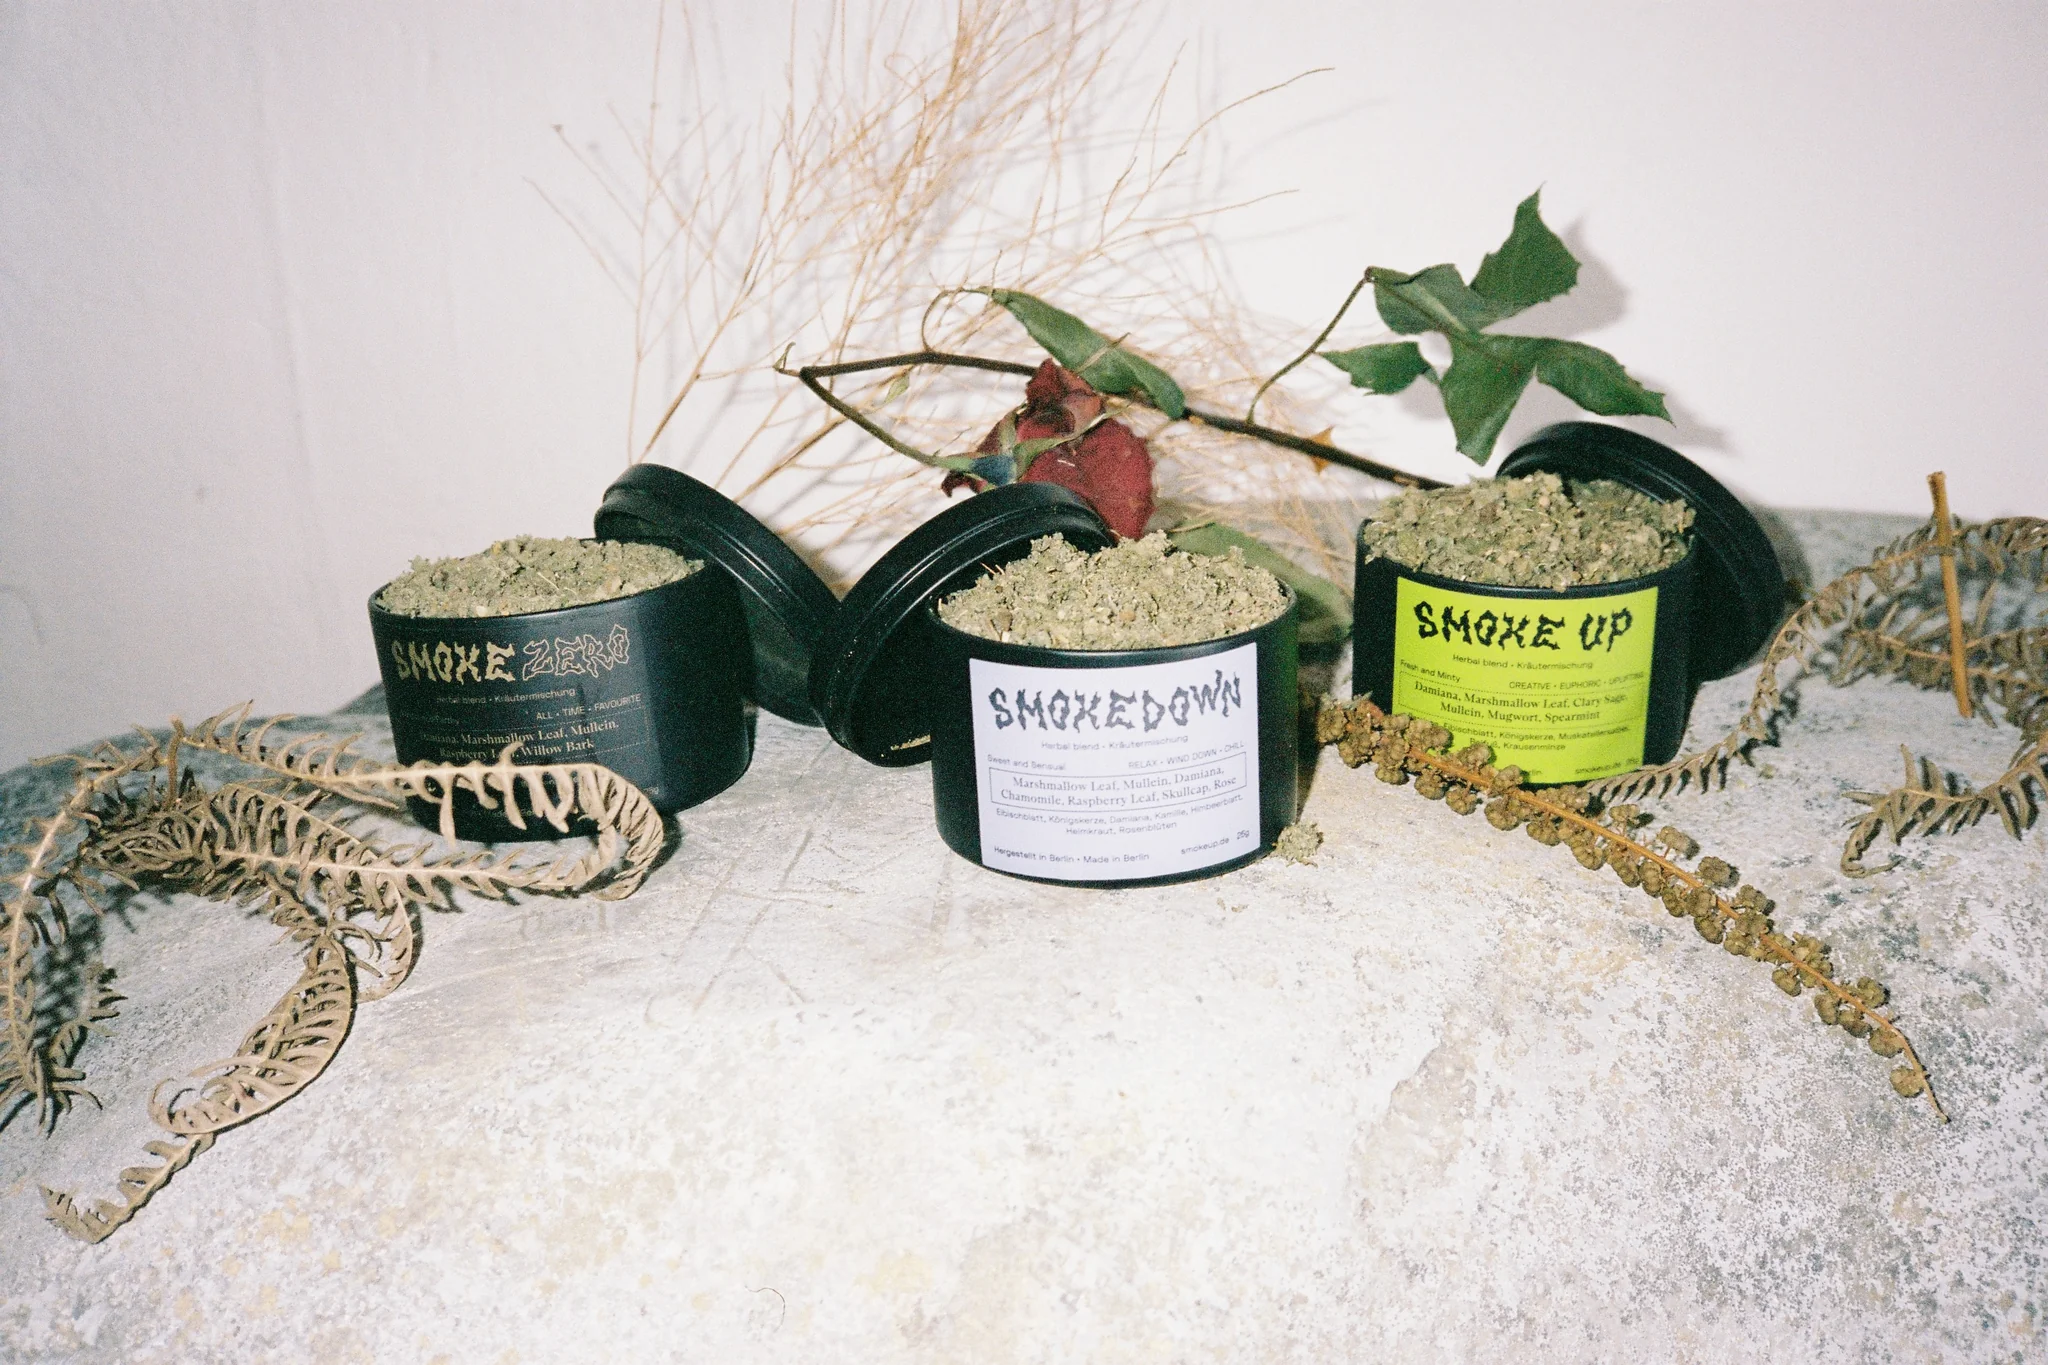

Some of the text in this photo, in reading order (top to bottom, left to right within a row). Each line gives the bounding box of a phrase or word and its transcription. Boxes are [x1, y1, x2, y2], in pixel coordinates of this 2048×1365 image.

[1413, 600, 1633, 652] SMOKE UP
[391, 623, 630, 685] SMOKE ZERO
[1453, 654, 1593, 670] Herbal blend Kräutermischung
[1400, 659, 1461, 683] Fresh and Minty
[1509, 681, 1551, 690] CREATIVE
[1560, 679, 1601, 690] EUPHORIC
[988, 669, 1241, 733] SMOKEDOWN
[1415, 681, 1461, 701] Damiana,
[1464, 693, 1539, 709] Marshmallow
[1543, 698, 1570, 709] Leaf,
[1573, 697, 1600, 708] Clary
[536, 693, 641, 720] ALL TIME FAVOURITE
[1440, 702, 1600, 724] Mullein, Mugwort, Spearmint
[460, 732, 534, 745] Marshmallow
[1041, 735, 1189, 751] Herbal blend Kräutermischung
[1500, 731, 1556, 742] Königskerze,
[521, 742, 562, 757] Willow
[566, 739, 595, 752] Bark
[1128, 740, 1245, 770] RELAX WIND DOWN CHILL
[987, 753, 1067, 771] Sweet and Sensual
[1013, 767, 1225, 792] Marshmallow Leaf, Mullein, Damiana,
[1001, 777, 1237, 808] Chamomile, Raspberry Leaf, Skullcap, Rose
[1049, 815, 1107, 826] Königskerze,
[1110, 814, 1152, 823] Damiana,
[1155, 809, 1189, 820] Kamille,
[1119, 821, 1177, 834] Rosenblüten
[994, 845, 1036, 860] Hergestellt
[1049, 854, 1075, 863] Berlin
[1123, 853, 1150, 863] Berlin
[1181, 838, 1230, 855] smokeup.de
